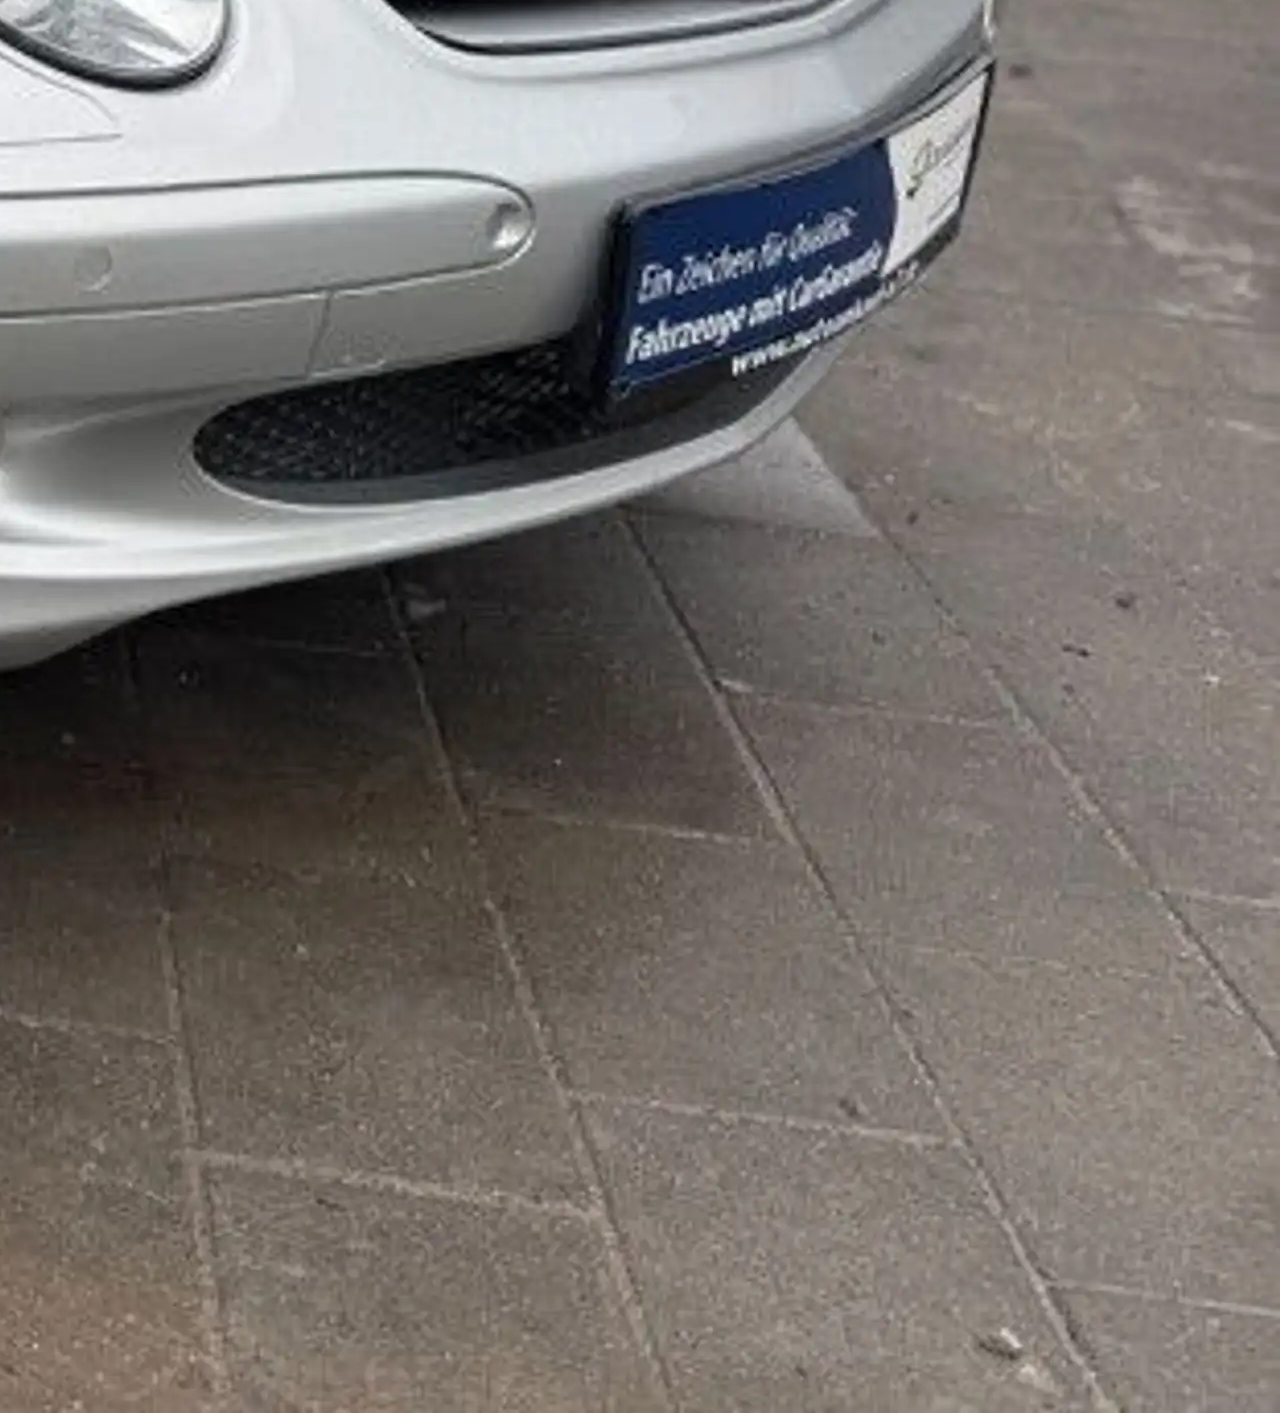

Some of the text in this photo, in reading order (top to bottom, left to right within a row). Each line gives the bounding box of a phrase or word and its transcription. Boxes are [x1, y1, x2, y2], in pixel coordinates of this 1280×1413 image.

[637, 263, 673, 303] Ein
[675, 244, 757, 295] Zeichen
[625, 304, 747, 364] Fahrzeuge
[747, 285, 788, 327] mit
